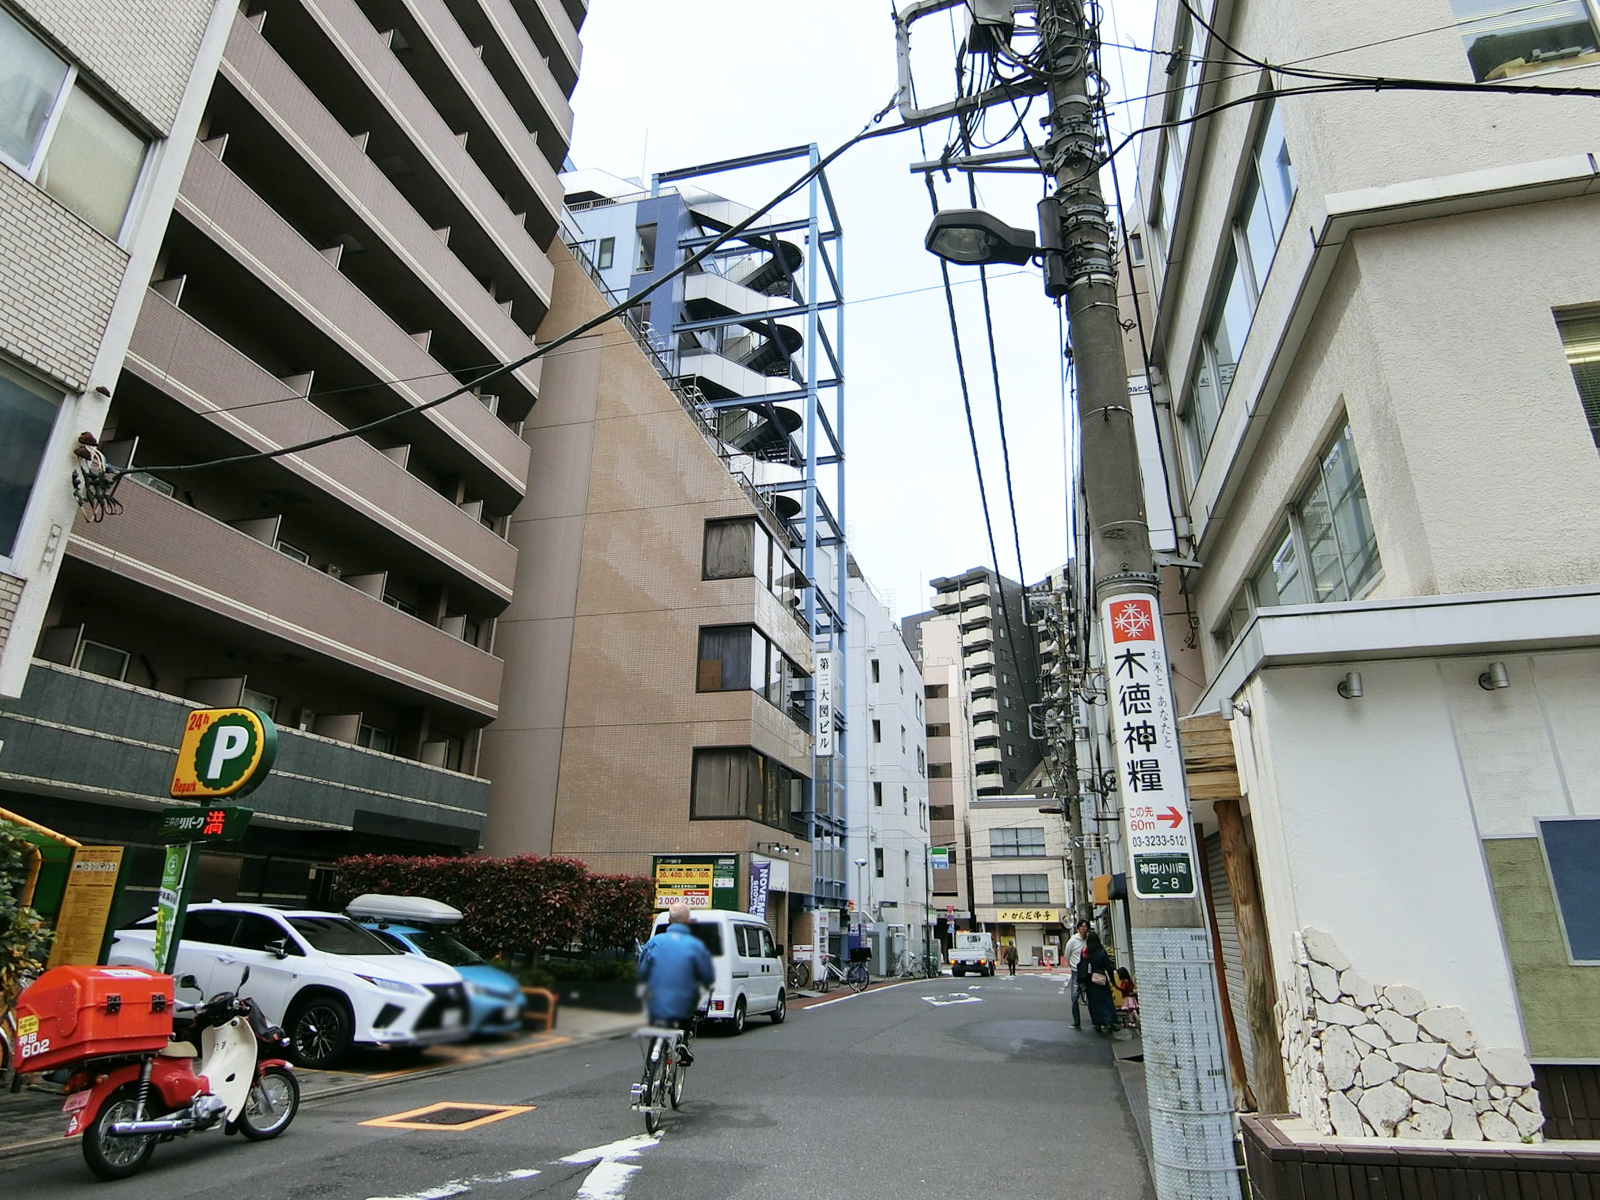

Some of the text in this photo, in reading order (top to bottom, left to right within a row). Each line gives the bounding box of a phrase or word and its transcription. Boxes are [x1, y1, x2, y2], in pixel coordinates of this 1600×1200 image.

[819, 658, 830, 749] 第三大図ビル
[1151, 648, 1175, 756] お米と。あなたと。
[188, 713, 210, 731] 24h
[1114, 648, 1164, 793] 木徳神糧
[206, 725, 250, 780] P
[173, 778, 197, 793] Repark
[1129, 806, 1154, 818] この先
[203, 810, 226, 835] 満
[1130, 819, 1156, 831] 60m
[1132, 835, 1188, 848] 03-3233-5121
[1139, 863, 1187, 875] 神田小川町
[1151, 877, 1180, 889] 2-8
[19, 1032, 38, 1047] 神田
[22, 1038, 50, 1058] 602
